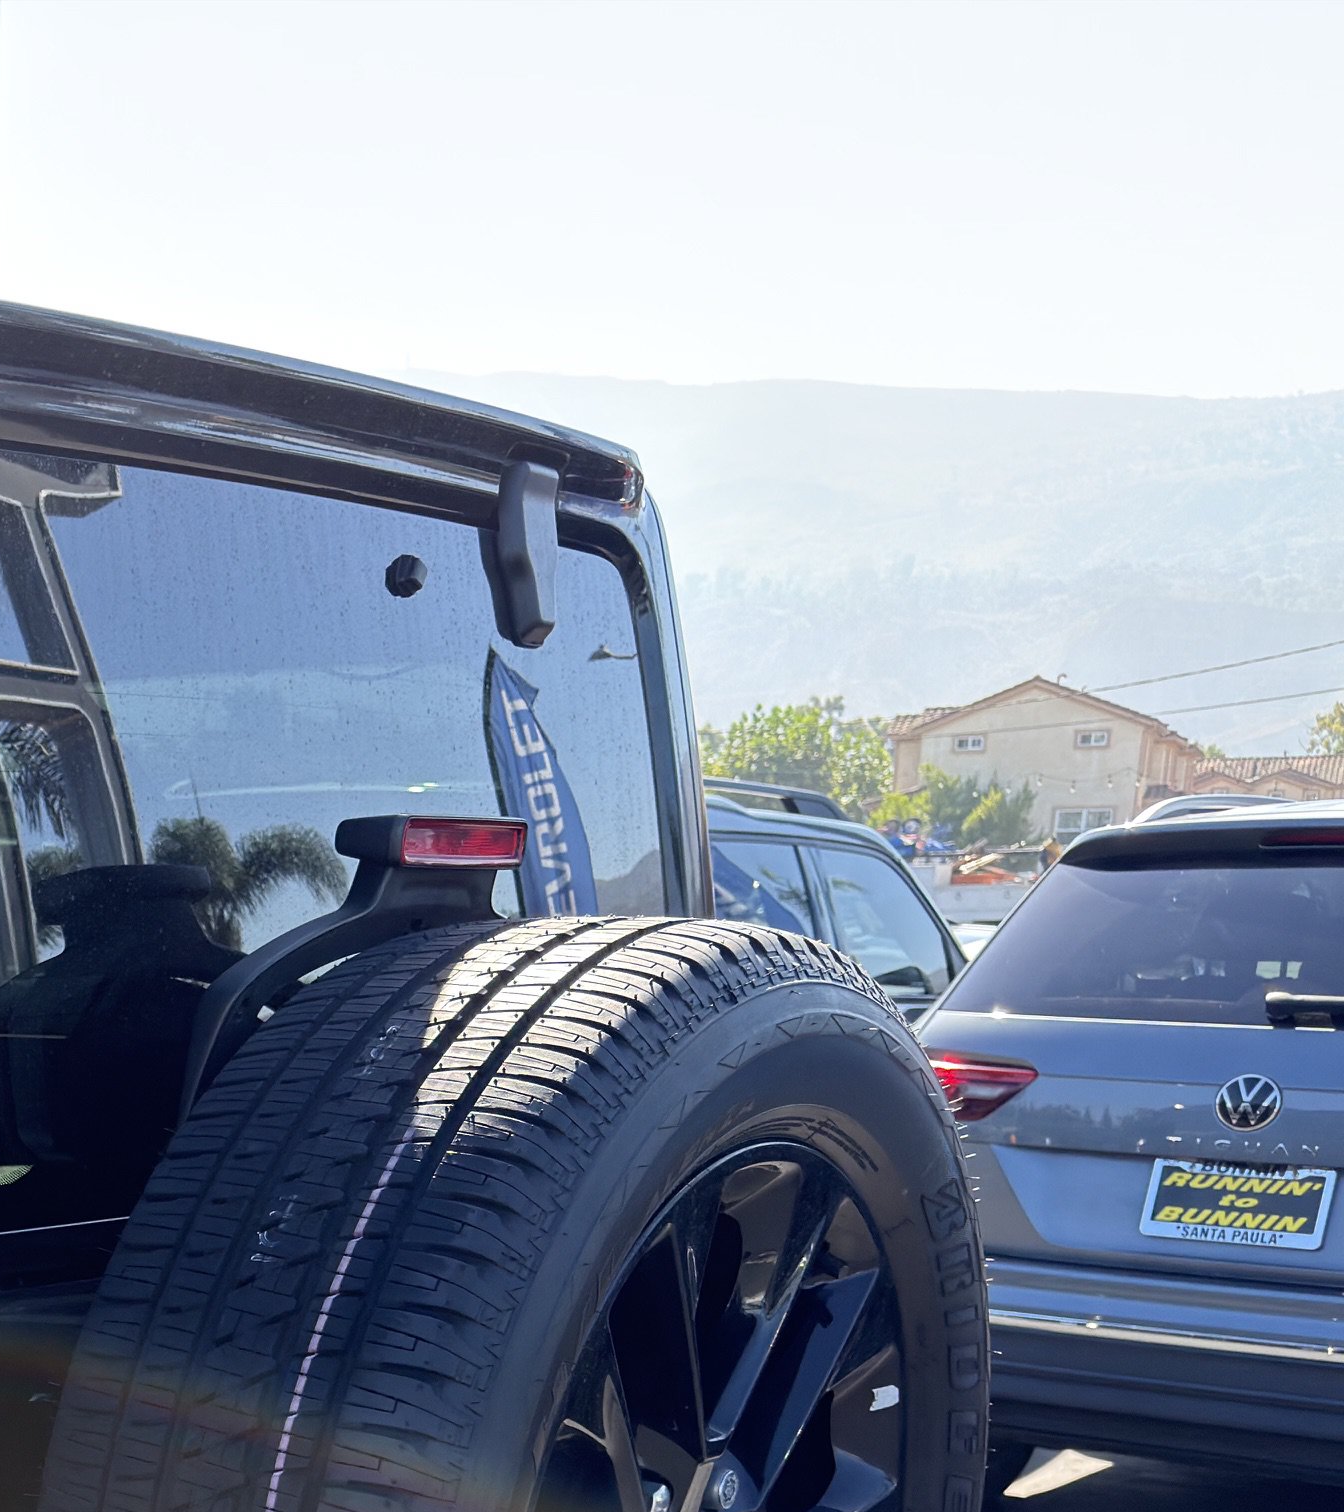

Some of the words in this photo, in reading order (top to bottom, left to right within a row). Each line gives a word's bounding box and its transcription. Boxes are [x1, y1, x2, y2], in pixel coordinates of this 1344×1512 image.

[1163, 1171, 1323, 1197] RUNNIN'
[1218, 1193, 1259, 1208] to
[1154, 1205, 1307, 1233] BUNNIN
[1181, 1225, 1226, 1241] SANTA
[1232, 1230, 1278, 1245] PAULA
